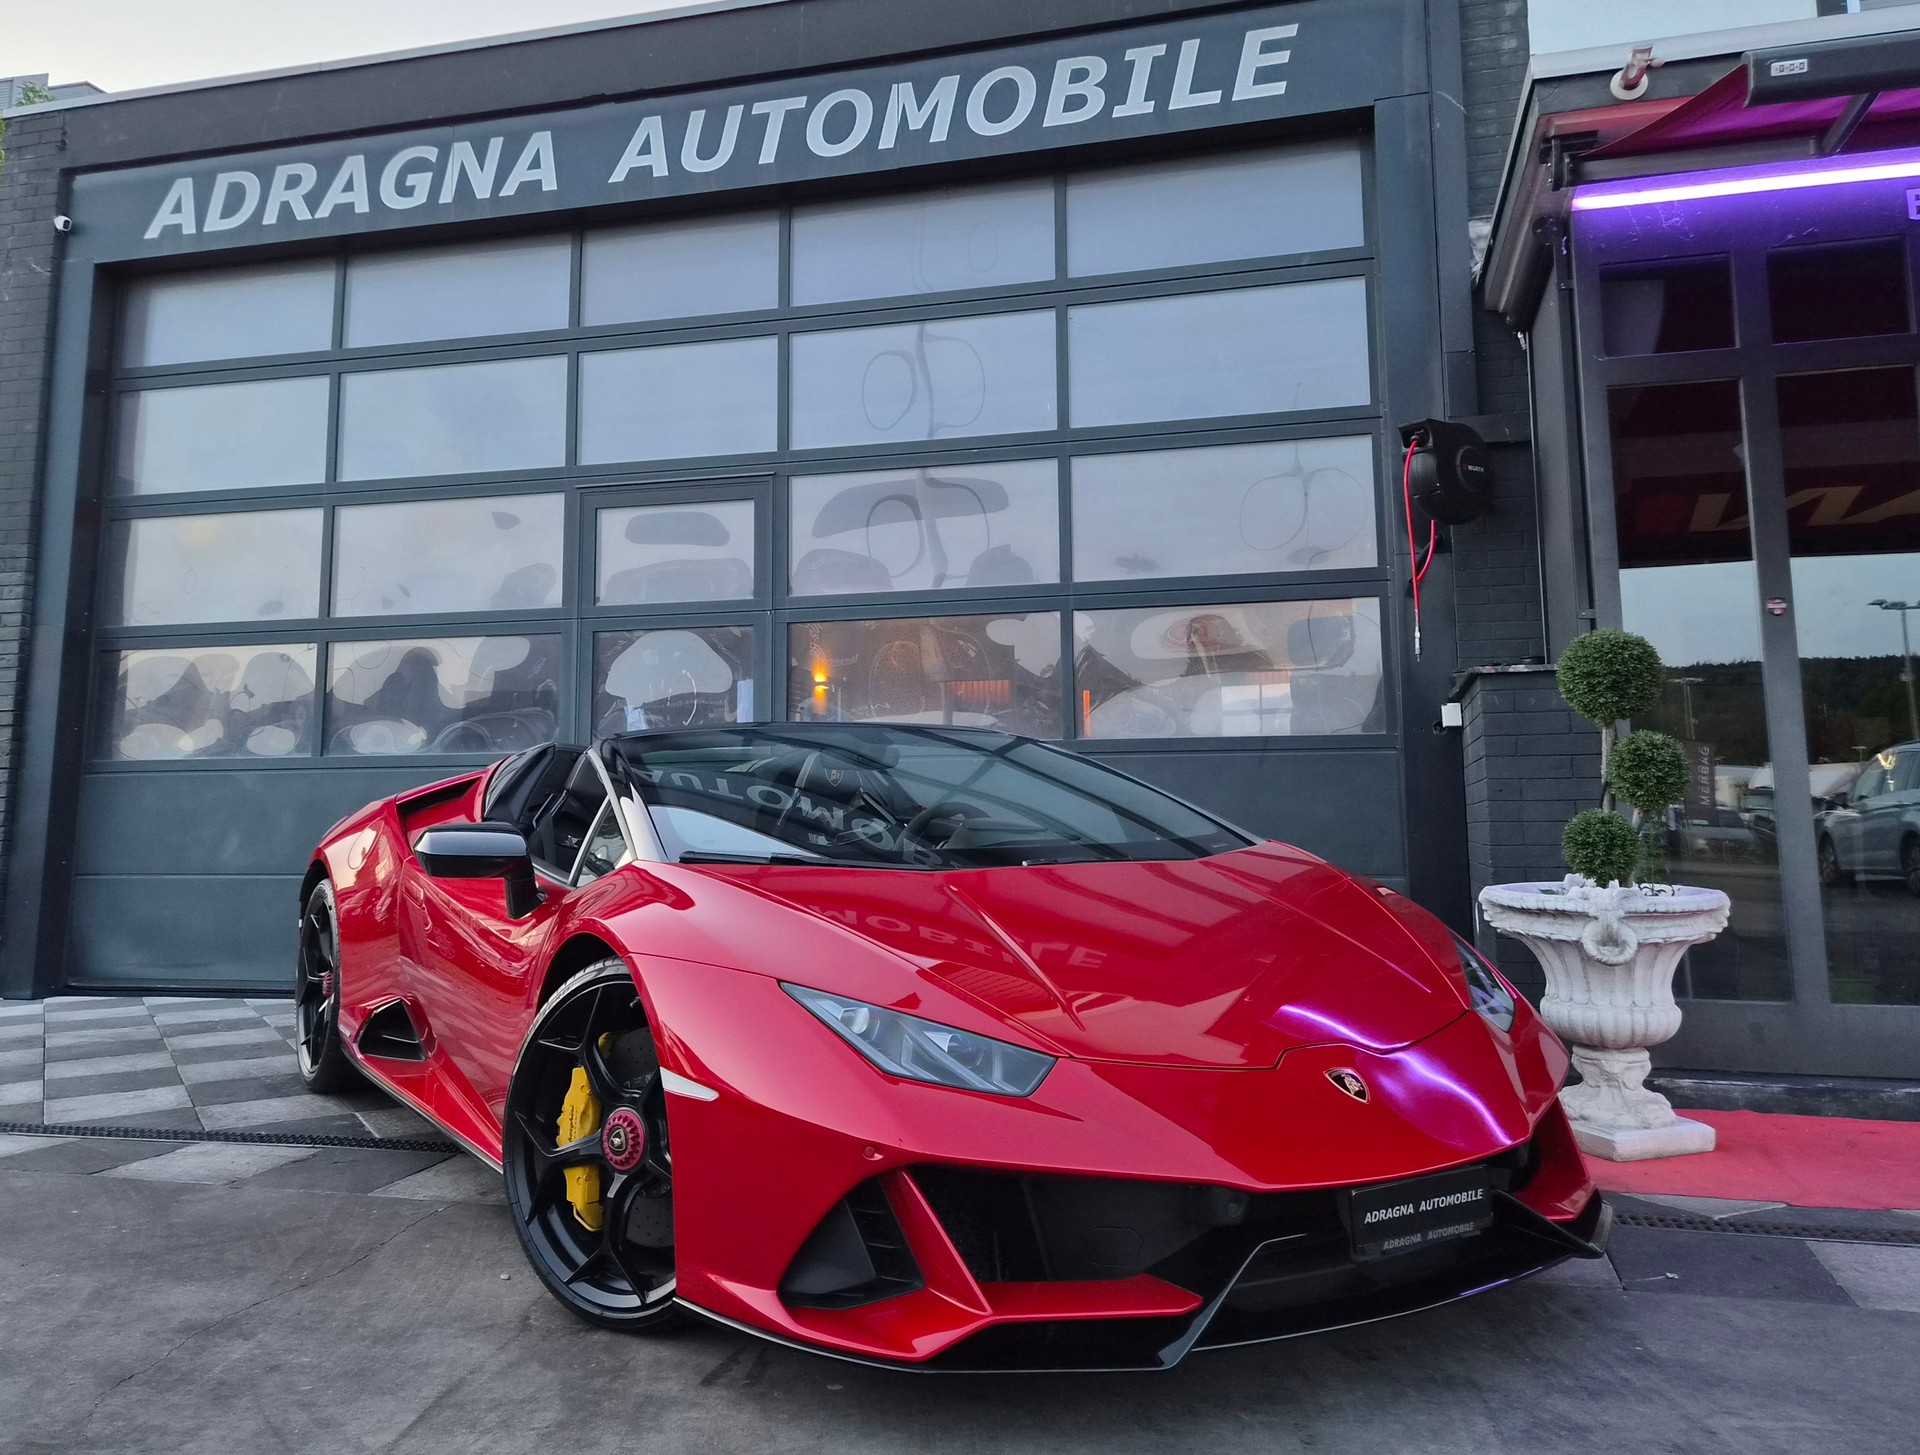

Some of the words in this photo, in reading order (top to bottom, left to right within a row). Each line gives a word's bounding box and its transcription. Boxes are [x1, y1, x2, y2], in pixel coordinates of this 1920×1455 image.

[143, 130, 558, 240] ADRAGNA
[608, 23, 1299, 183] AUTOMOBILE
[1364, 1203, 1414, 1224] ADRAGNA
[1419, 1188, 1483, 1212] AUTOMOBILE
[1383, 1233, 1422, 1251] ADRAGNA
[1427, 1222, 1474, 1240] AUTOMOBILE
